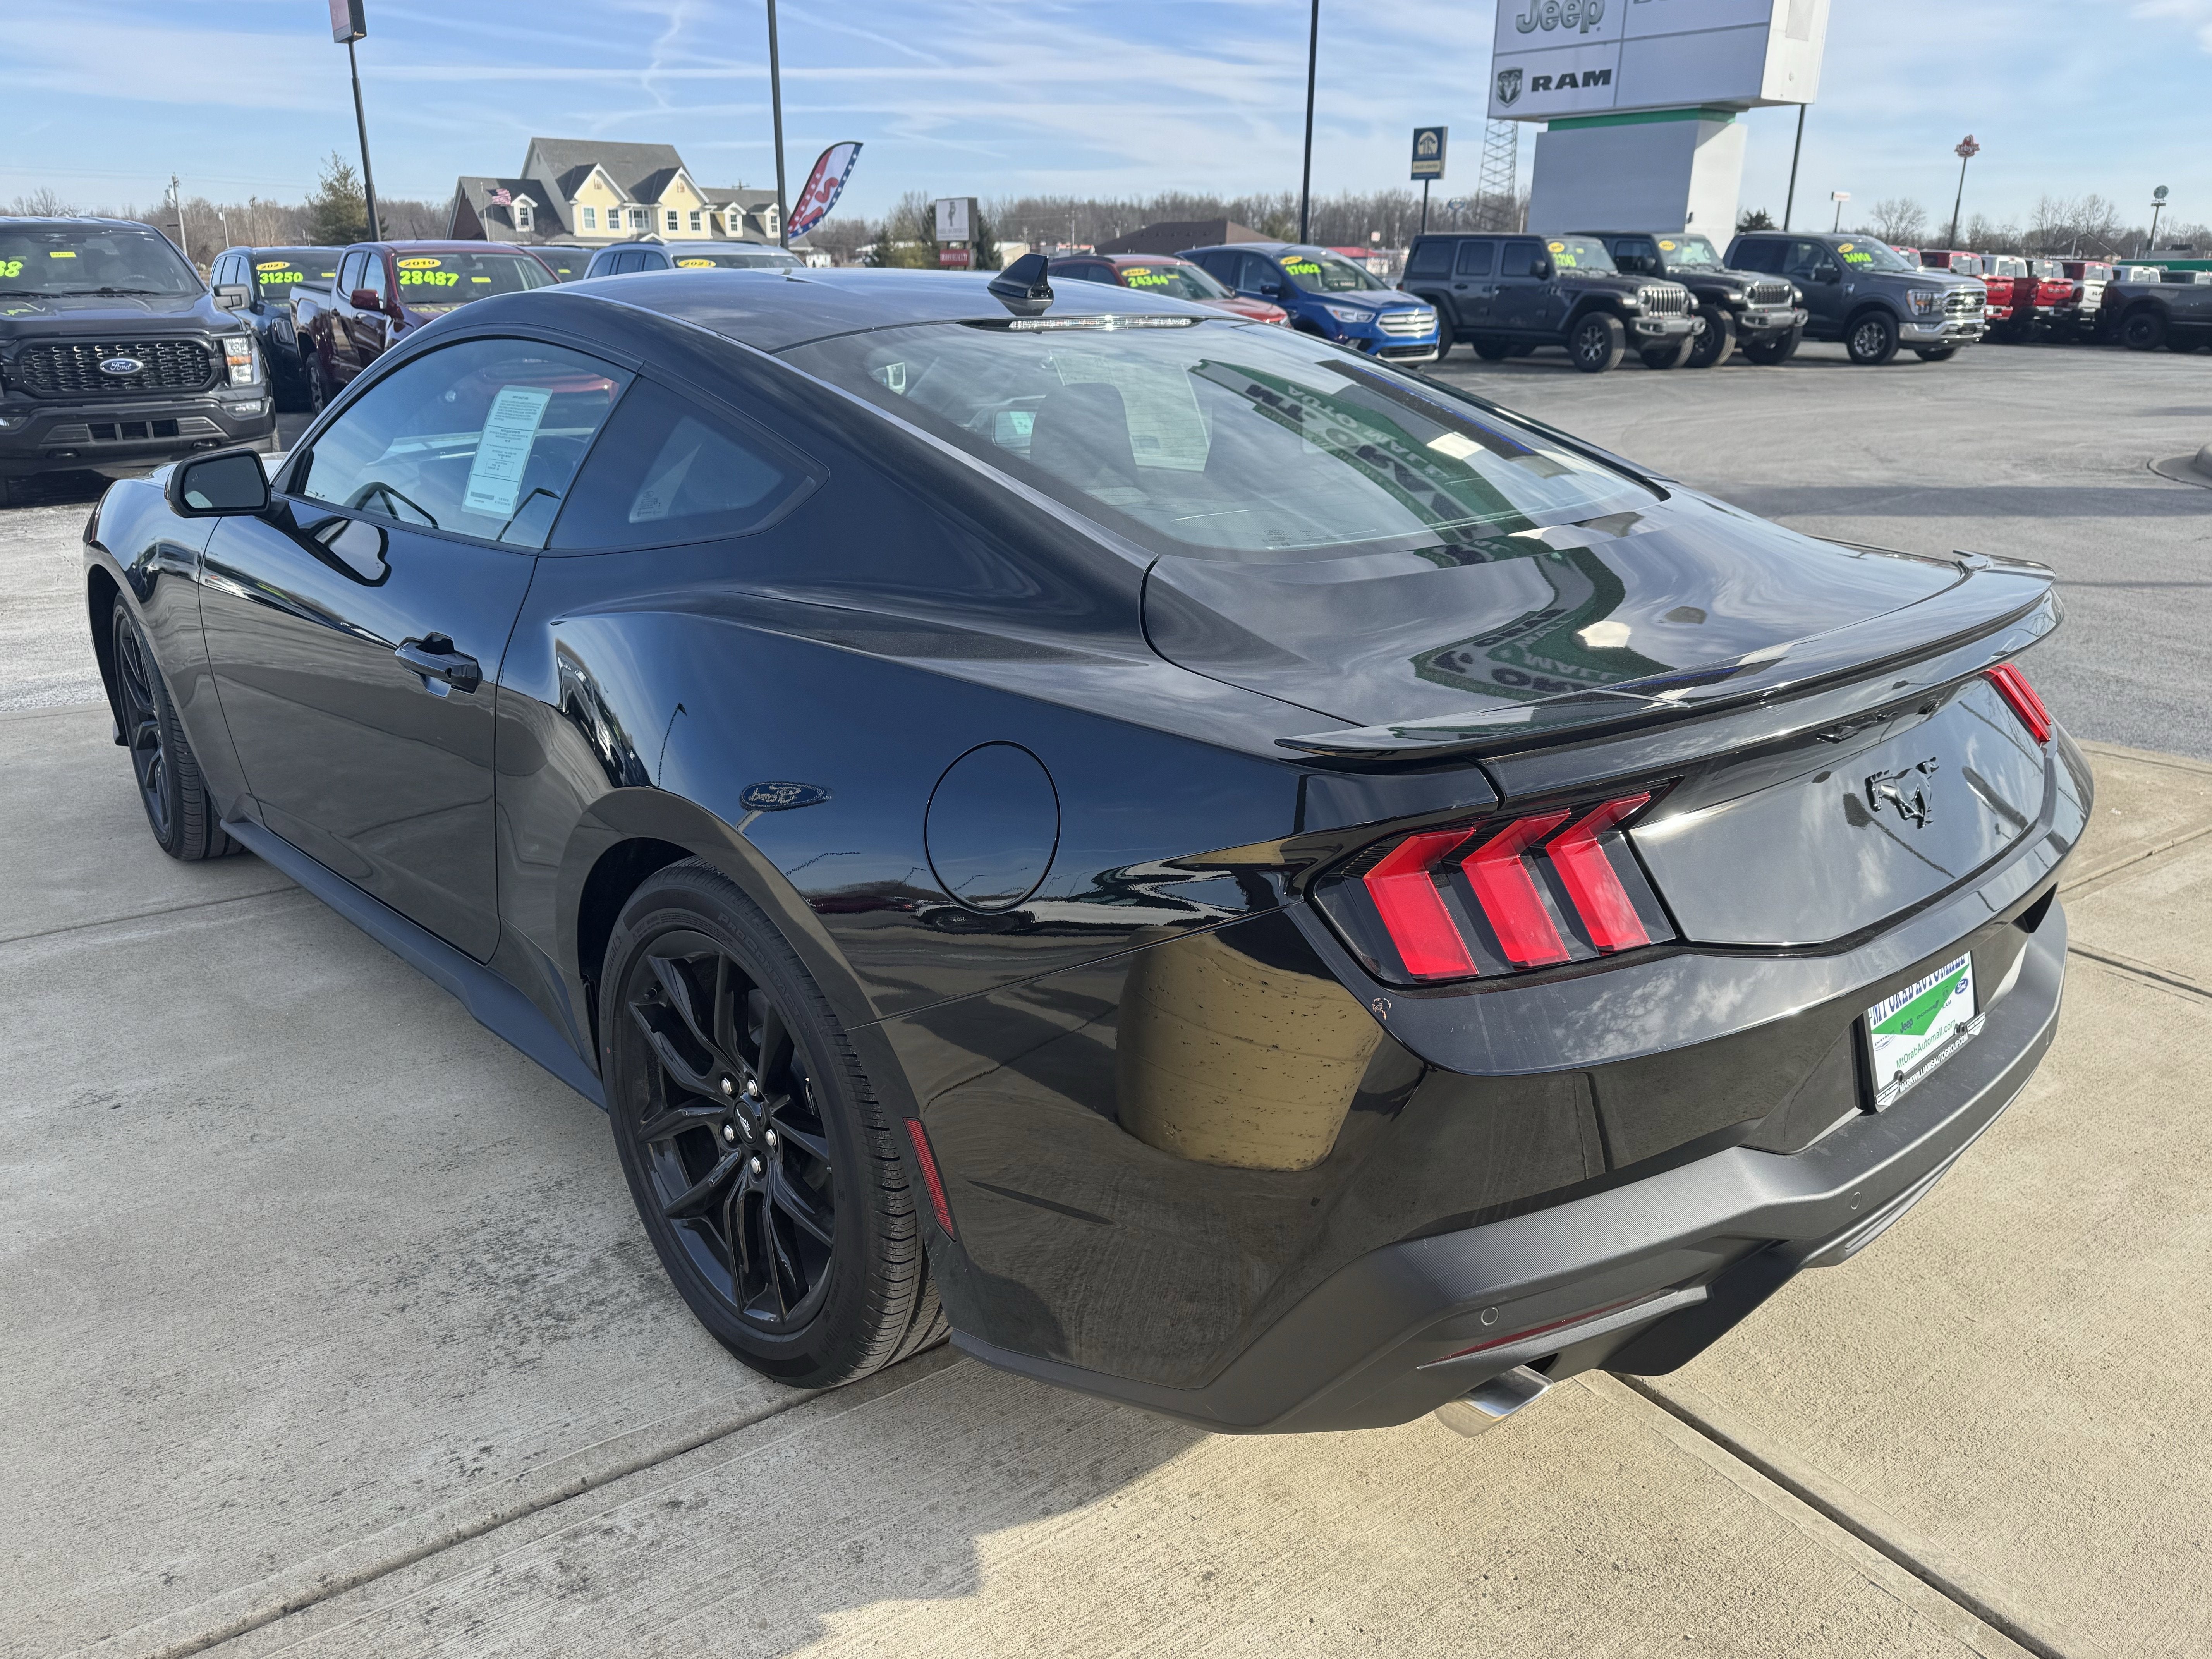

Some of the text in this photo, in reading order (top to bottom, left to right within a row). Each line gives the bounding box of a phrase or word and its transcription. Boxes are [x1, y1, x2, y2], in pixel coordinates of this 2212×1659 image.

[1515, 0, 1605, 34] Jeep
[1531, 69, 1612, 92] RAM
[259, 272, 304, 285] 31250
[399, 270, 459, 287] 28487
[1127, 274, 1169, 287] 24344
[1900, 1018, 1913, 1034] Jeep
[1896, 1019, 1956, 1069] MtOrabAutomall.com
[1899, 1032, 1969, 1093] MARKWILLIAMSAUTOGROUP.COM
